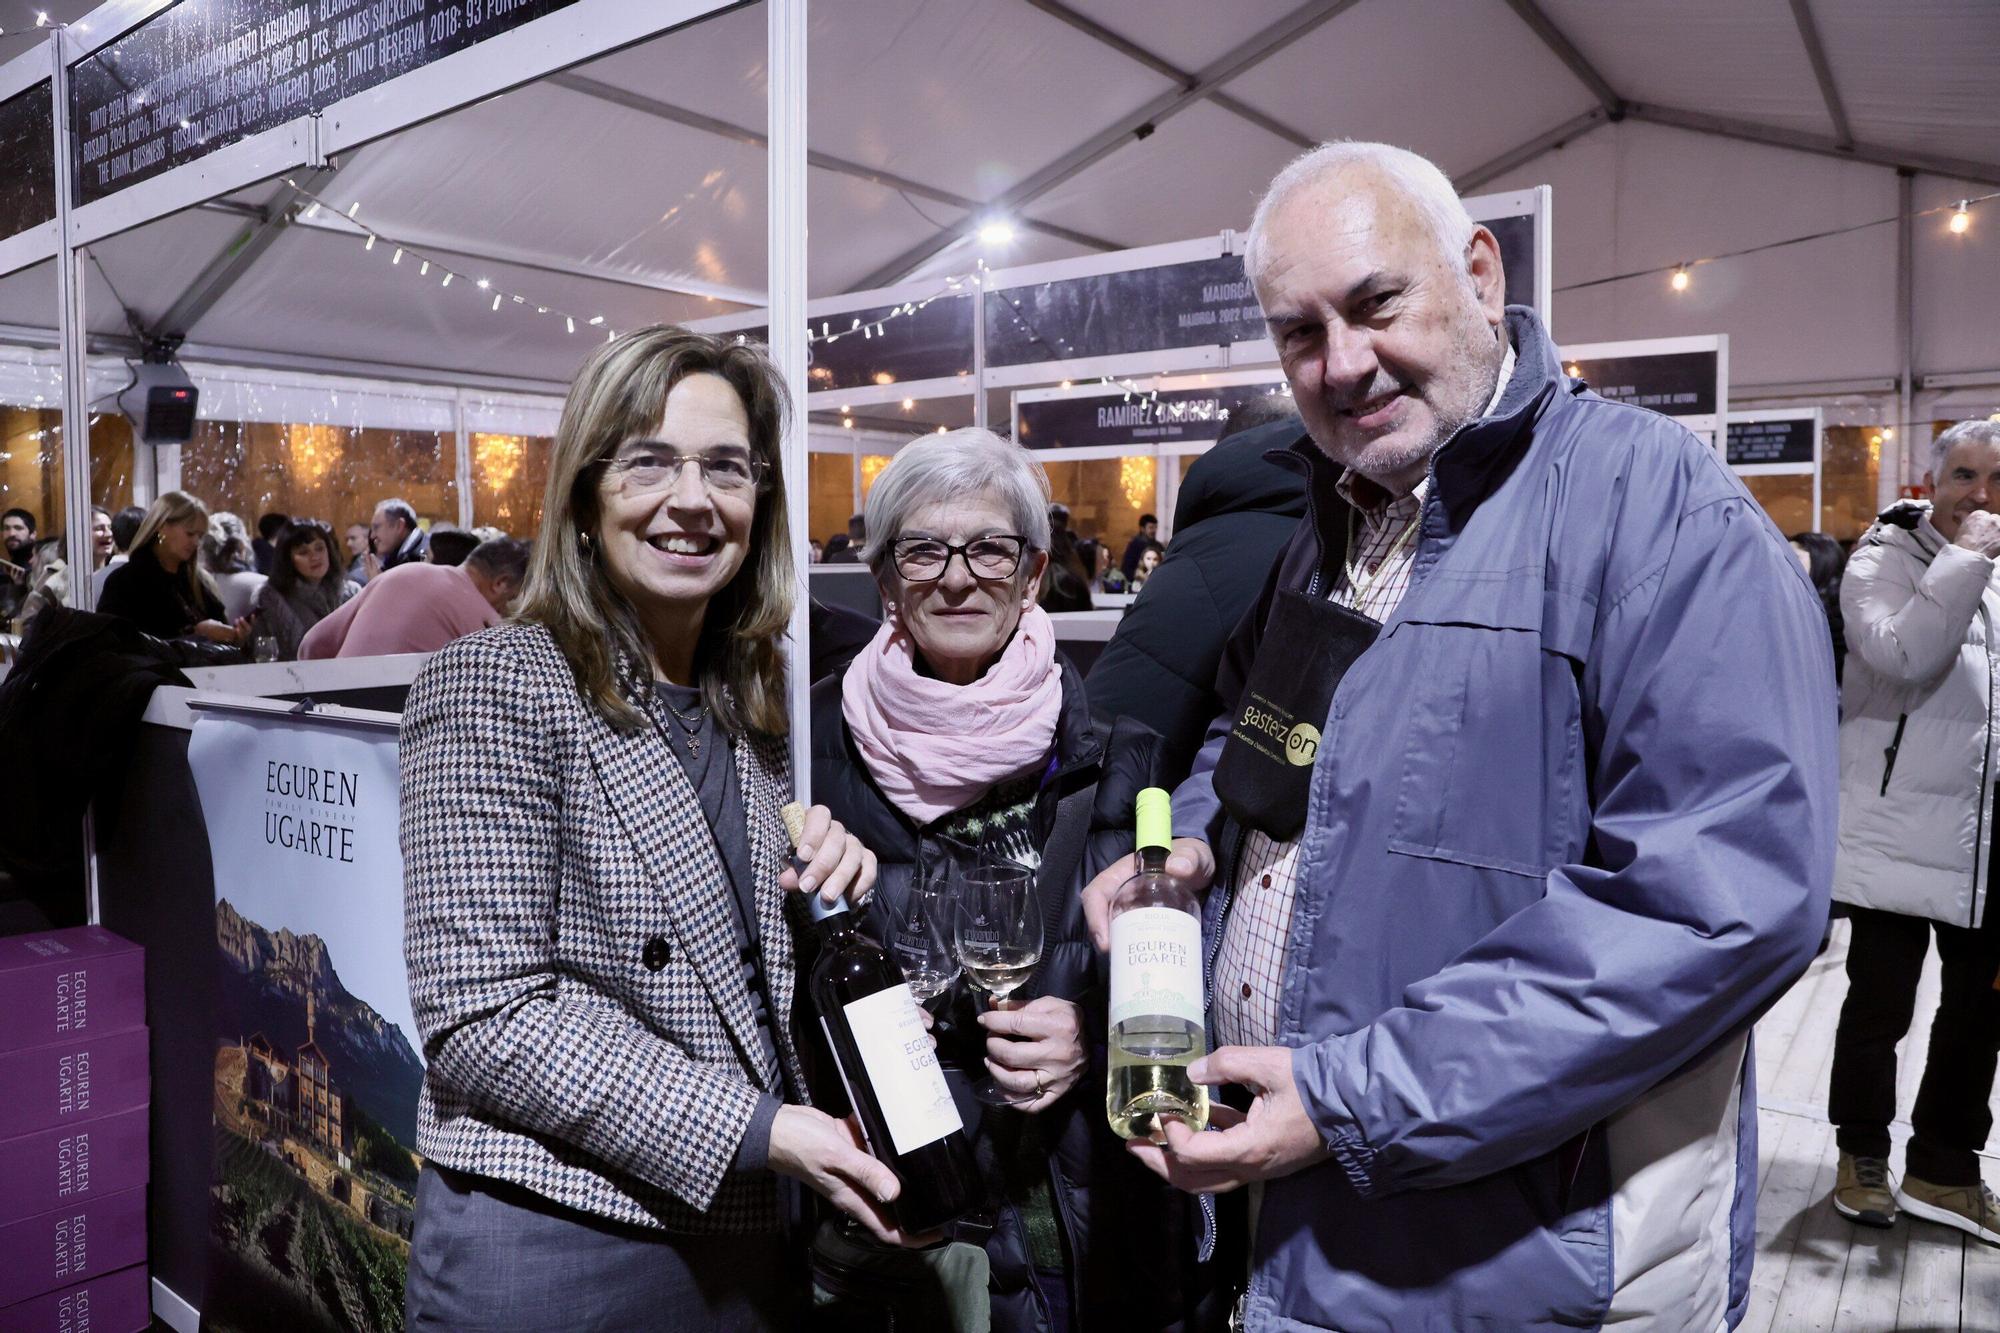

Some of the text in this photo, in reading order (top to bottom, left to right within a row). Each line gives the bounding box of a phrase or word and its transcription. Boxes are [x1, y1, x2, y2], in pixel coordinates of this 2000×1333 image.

[83, 133, 108, 164] ROSADO
[110, 124, 126, 152] 2024
[128, 114, 150, 143] 100%
[231, 57, 267, 98] CRIANZA
[296, 38, 309, 67] 90
[312, 28, 331, 60] PTS.
[335, 9, 369, 49] JAMES
[90, 105, 107, 132] TINTO
[109, 96, 125, 124] 2024
[198, 29, 257, 82] AYUNTAMIENTO
[260, 3, 310, 51] LAGUARDIA
[98, 161, 109, 184] THE
[111, 151, 131, 180] DRINK
[132, 136, 165, 172] BUSINESS
[172, 120, 202, 154] ROSADO
[204, 103, 238, 142] CRIANZA
[268, 71, 309, 113] NOVEDAD
[313, 61, 337, 95] 2025
[346, 42, 375, 79] TINTO
[378, 20, 425, 66] RESERVA
[430, 5, 461, 43] 2018:
[466, 0, 481, 28] 93
[1203, 279, 1252, 303] MAIORGA
[267, 760, 358, 808] EGUREN
[265, 811, 354, 863] UGARTE
[1128, 941, 1187, 955] EGUREN
[1128, 952, 1187, 968] UGARTE
[57, 973, 69, 1032] UGARTE
[75, 970, 86, 1029] EGUREN
[59, 1056, 72, 1114] UGARTE
[77, 1052, 90, 1110] EGUREN
[58, 1138, 71, 1197] UGARTE
[76, 1133, 89, 1192] EGUREN
[55, 1220, 68, 1278] UGARTE
[73, 1214, 86, 1273] EGUREN
